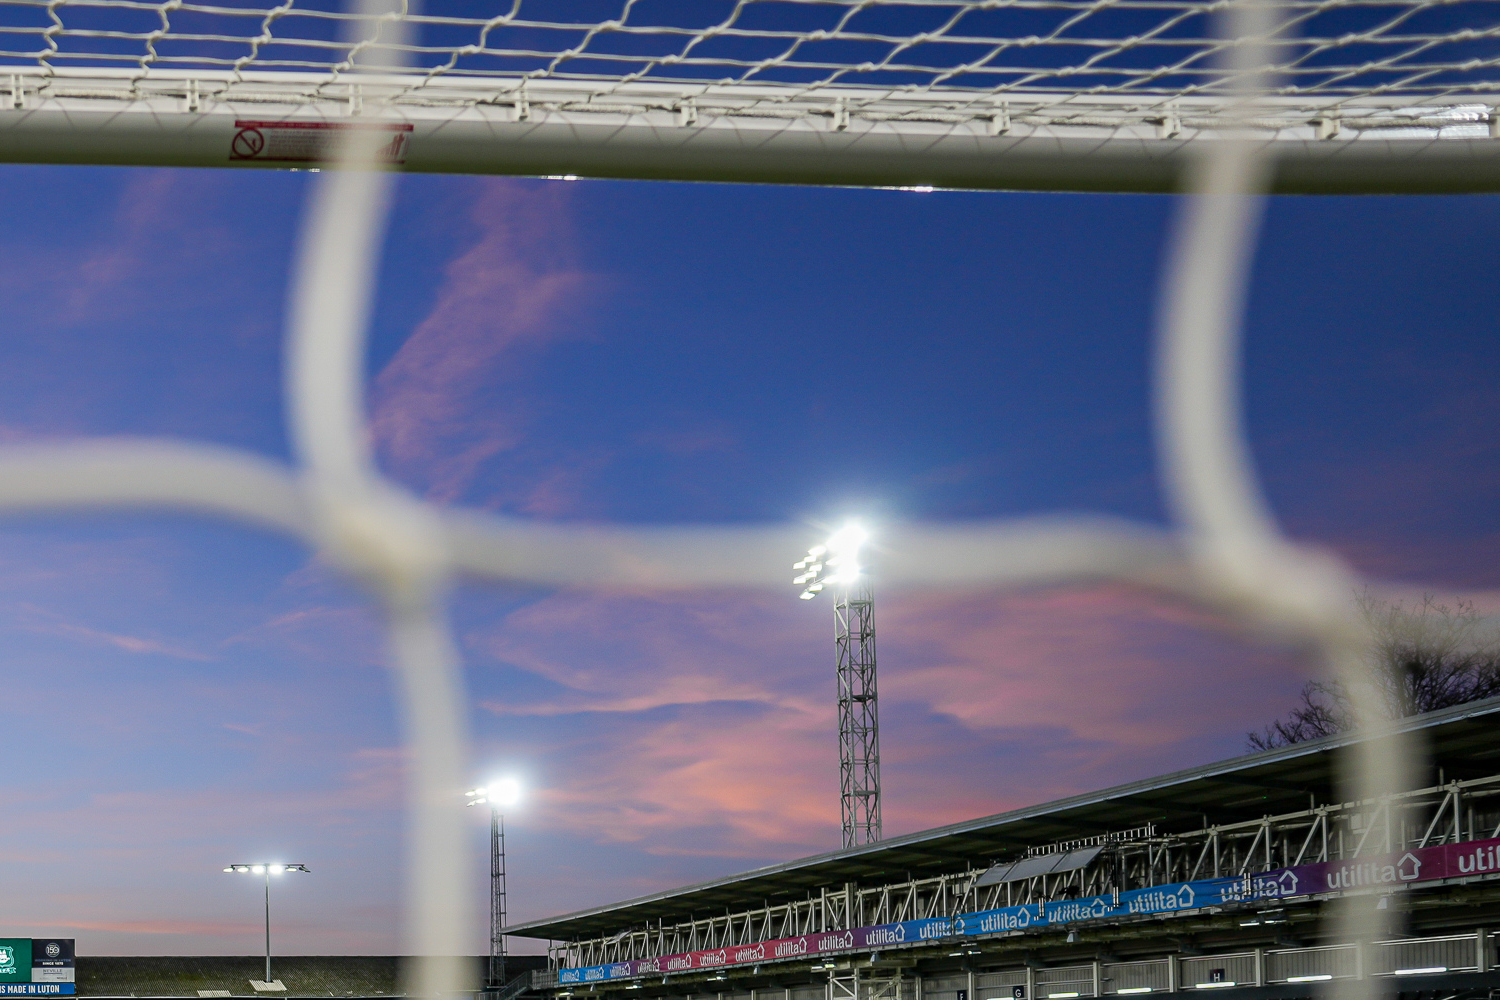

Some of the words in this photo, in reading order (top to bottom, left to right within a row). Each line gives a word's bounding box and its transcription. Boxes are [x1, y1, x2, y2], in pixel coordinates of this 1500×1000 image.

[1327, 863, 1396, 889] utilita
[1220, 880, 1278, 903] utilita
[1129, 894, 1177, 914] utilita
[1049, 905, 1092, 924] utilita
[981, 914, 1018, 932] utilita
[920, 922, 953, 939] utilita
[819, 936, 845, 950] utilita
[866, 930, 896, 946] utilita
[736, 949, 758, 962] utilita
[775, 943, 800, 957] utilita
[668, 958, 686, 969] utilita
[700, 954, 720, 966] utilita
[1213, 972, 1221, 983] H
[0, 986, 6, 994] IS
[8, 986, 27, 994] MADE
[28, 985, 36, 993] IN
[38, 985, 60, 993] LUTON
[1015, 989, 1022, 998] G
